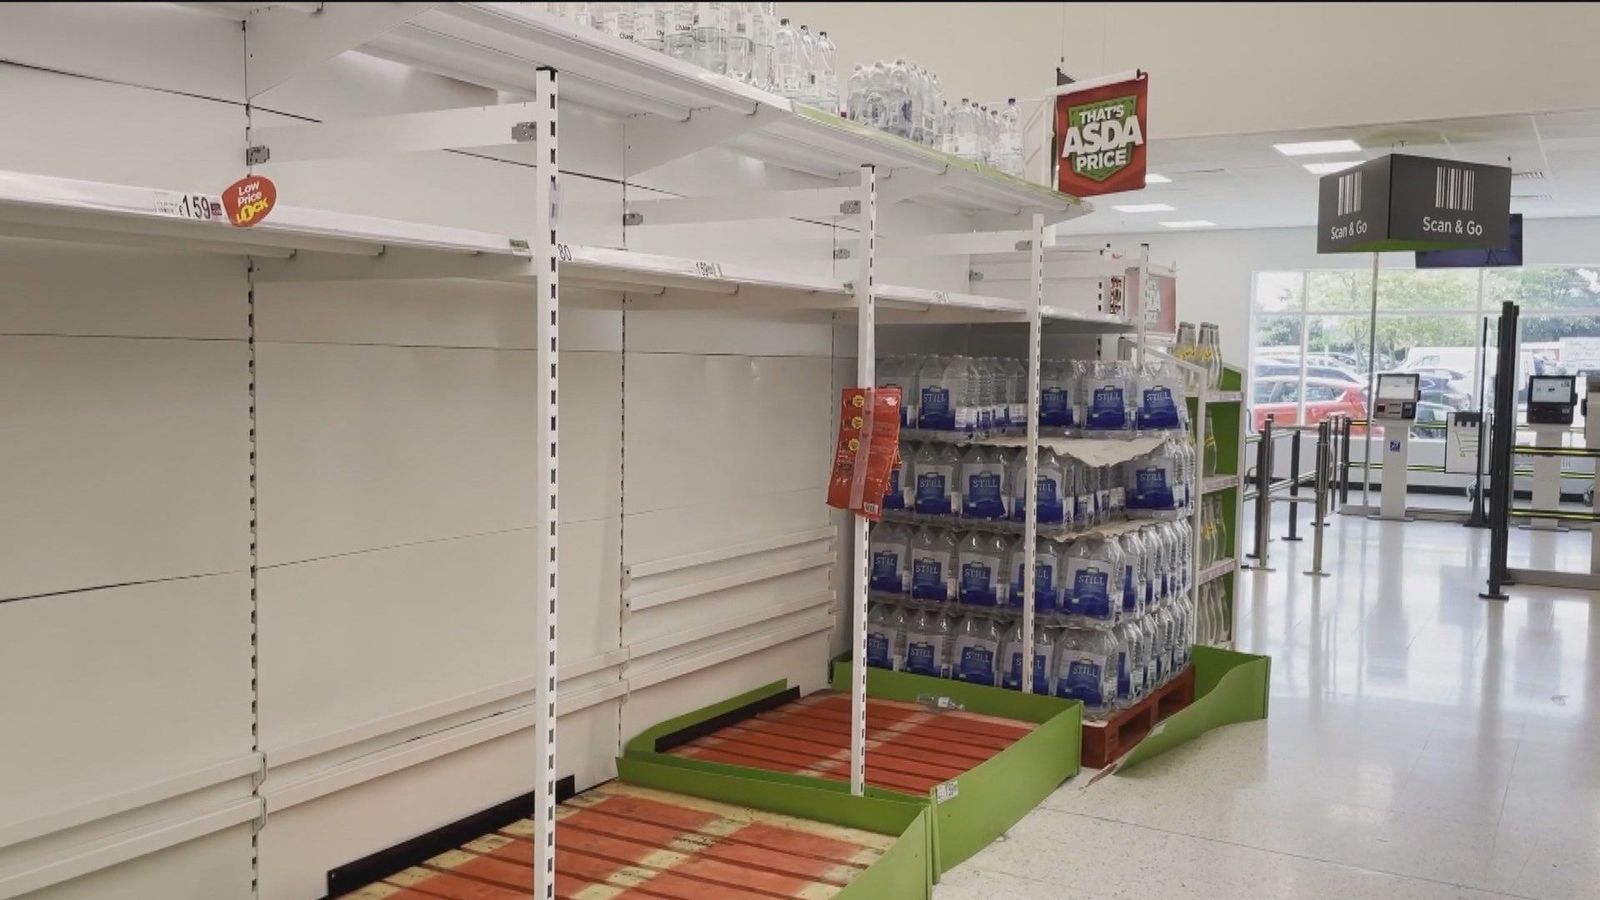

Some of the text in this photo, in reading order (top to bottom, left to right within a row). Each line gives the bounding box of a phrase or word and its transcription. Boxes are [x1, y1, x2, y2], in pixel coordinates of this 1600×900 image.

[1079, 104, 1125, 125] THAT'S
[1061, 115, 1144, 158] ASDA
[1076, 148, 1127, 172] PRICE
[238, 181, 260, 196] Low
[1330, 219, 1368, 241] Scan & Go
[1422, 216, 1483, 236] Scan & Go
[919, 478, 942, 489] STILL
[972, 479, 998, 489] STILL
[915, 564, 939, 574] STILL
[964, 568, 989, 580] STILL
[1078, 575, 1105, 586] STILL
[910, 647, 932, 658] STILL
[1072, 665, 1097, 678] STILL
